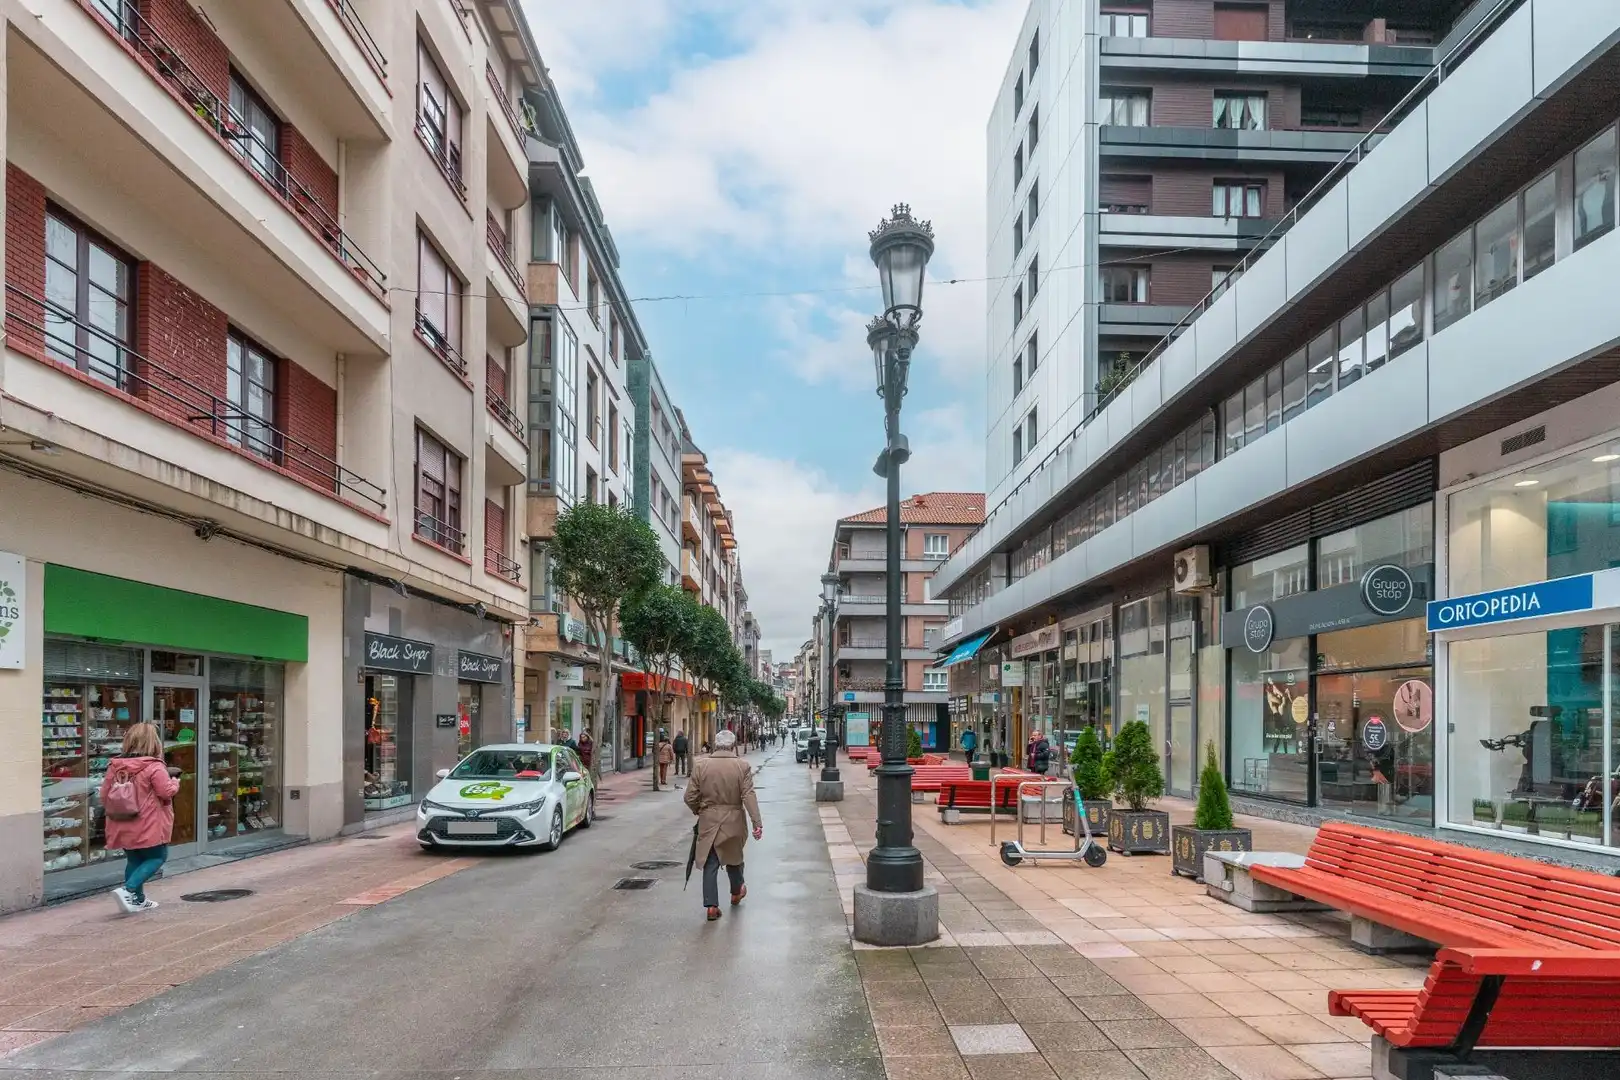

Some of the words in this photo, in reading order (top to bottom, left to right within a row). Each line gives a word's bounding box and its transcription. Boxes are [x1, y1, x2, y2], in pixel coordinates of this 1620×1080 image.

[1372, 578, 1406, 594] Grupo
[1376, 589, 1402, 600] stop
[1438, 591, 1541, 623] ORTOPEDIA
[1248, 619, 1268, 630] Grupo
[1250, 629, 1266, 639] stop
[369, 641, 400, 659] Black
[460, 658, 480, 672] Black
